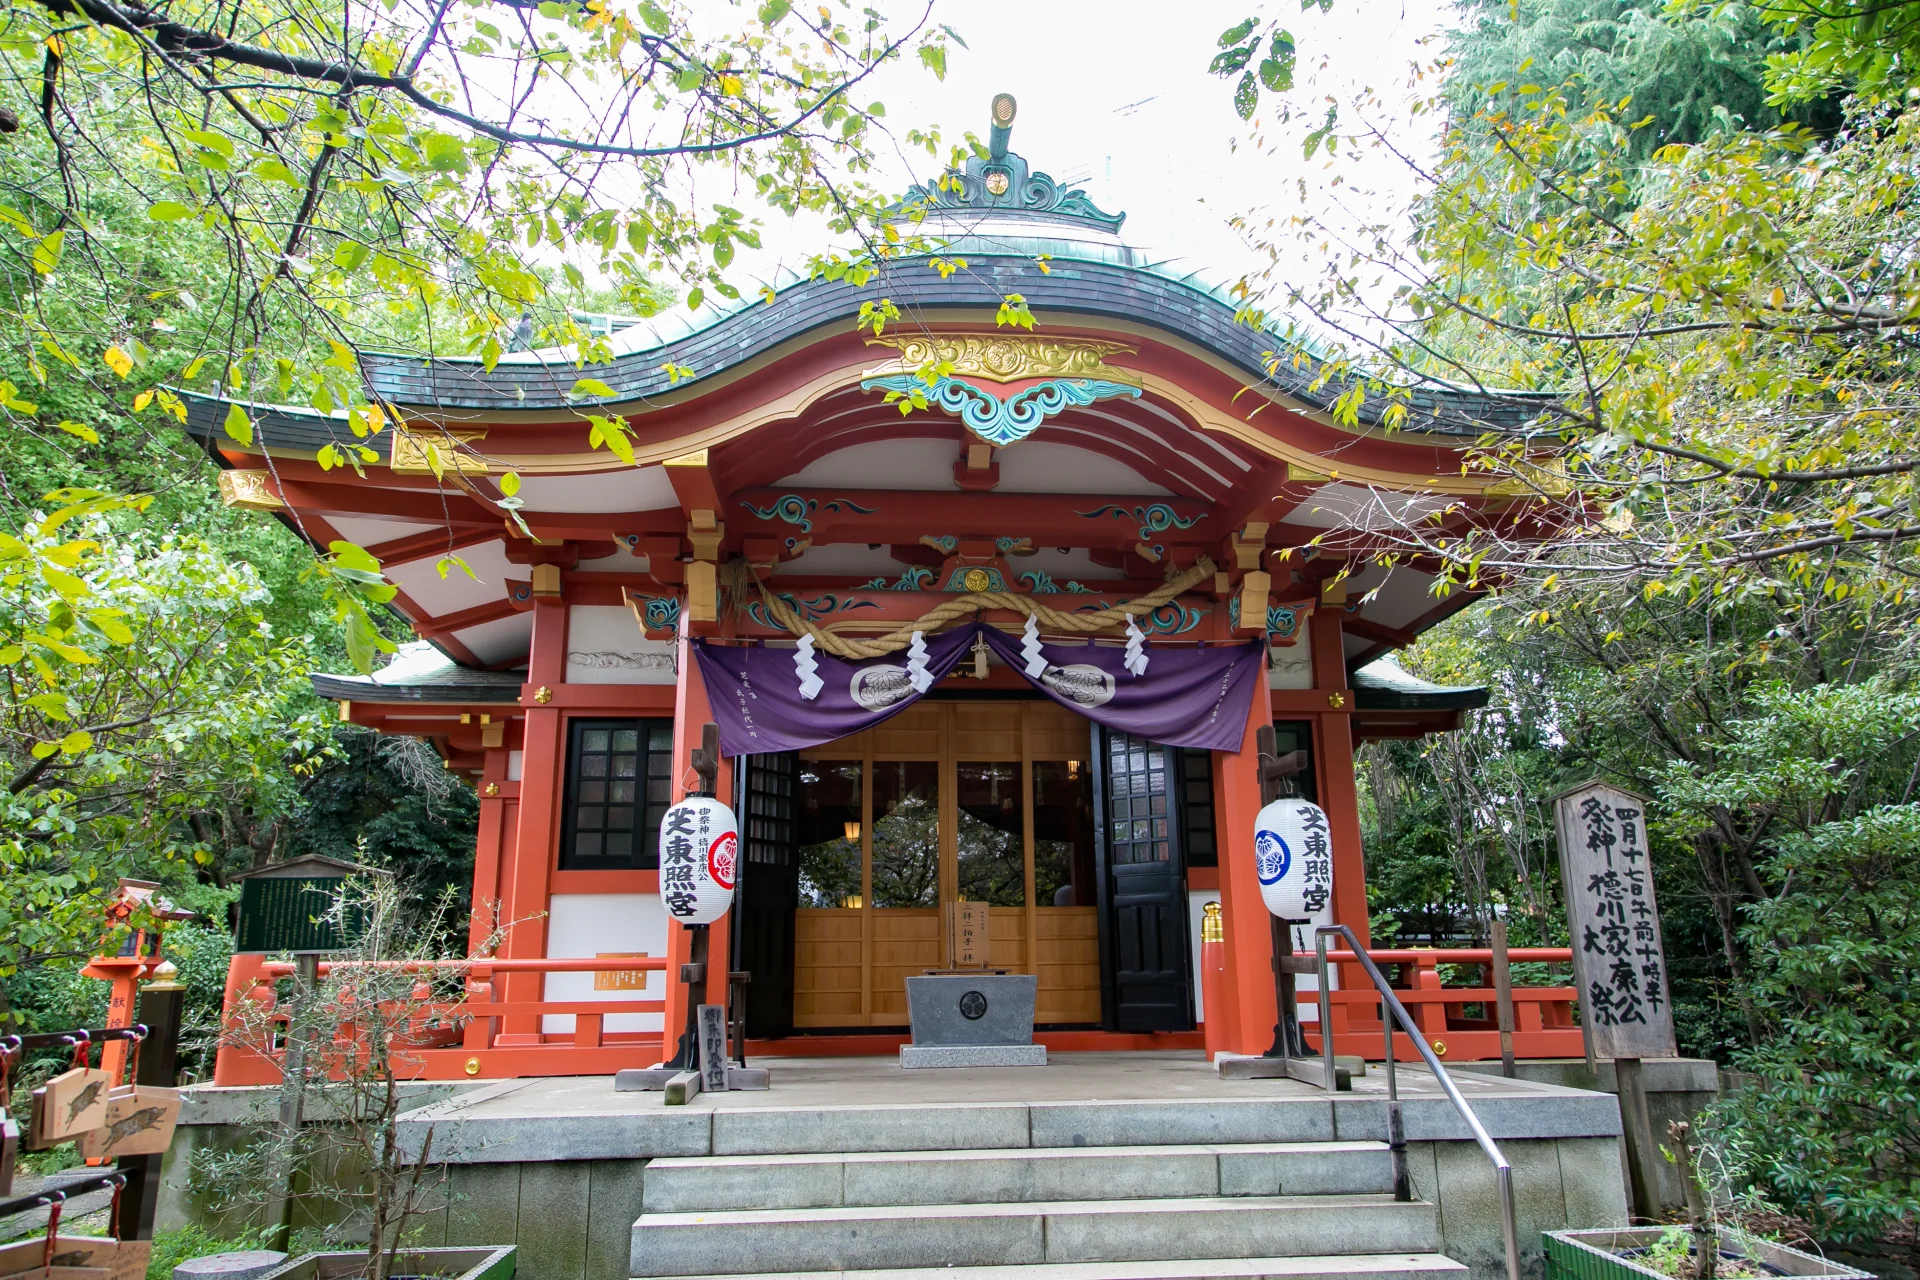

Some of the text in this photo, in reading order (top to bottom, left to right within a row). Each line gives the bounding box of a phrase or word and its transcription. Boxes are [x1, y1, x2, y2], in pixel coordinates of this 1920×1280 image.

[664, 807, 698, 917] 芝東照宮
[1296, 806, 1330, 913] 芝東照宮
[1616, 807, 1664, 1014] 四月十七日午前十時半
[963, 904, 974, 962] 二拝二拍手一拝
